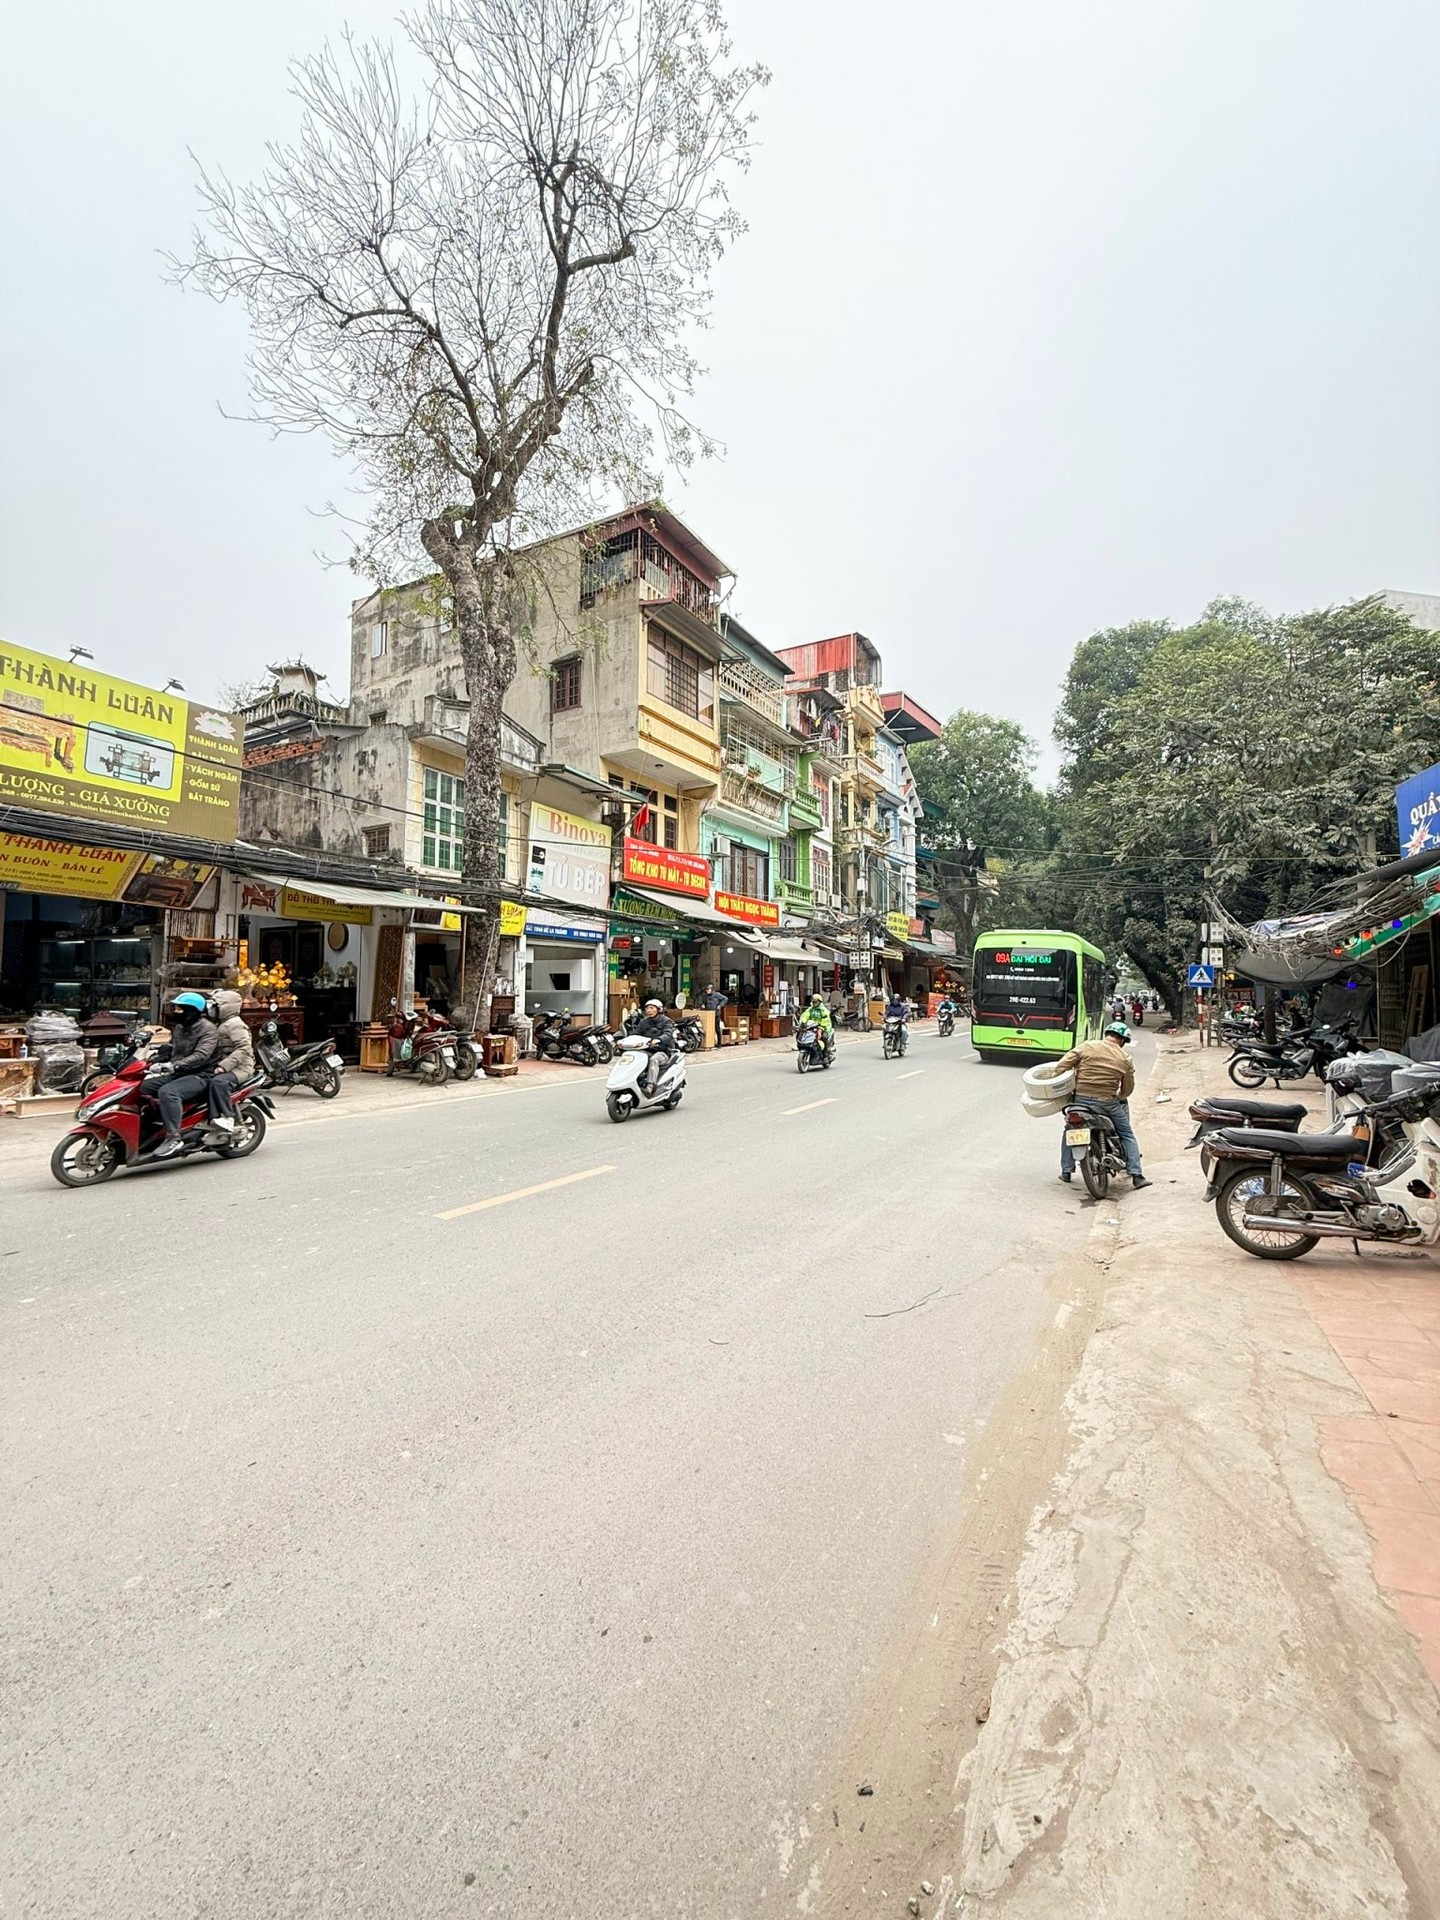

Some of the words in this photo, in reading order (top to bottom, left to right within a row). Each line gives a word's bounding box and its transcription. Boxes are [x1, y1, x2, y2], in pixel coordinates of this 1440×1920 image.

[0, 656, 97, 702] THÀNH
[108, 689, 174, 724] LUÂN
[189, 734, 217, 749] THÀNH
[218, 743, 239, 755] LUÂN
[190, 764, 214, 777] VÁCH
[0, 773, 65, 797] LƯỢNG
[79, 789, 110, 806] GIÁ
[113, 795, 171, 817] XƯỞNG
[189, 778, 209, 790] GỐM
[210, 782, 221, 792] SỨ
[188, 791, 203, 802] BÁT
[549, 811, 607, 845] Binova
[13, 854, 51, 867] BUÔN
[62, 862, 88, 872] BÁN
[629, 853, 646, 875] TỔNG
[646, 863, 659, 878] KHO
[547, 856, 570, 889] TỦ
[573, 863, 606, 895] BẾP
[718, 895, 730, 911] NỘI
[730, 896, 744, 912] THẤT
